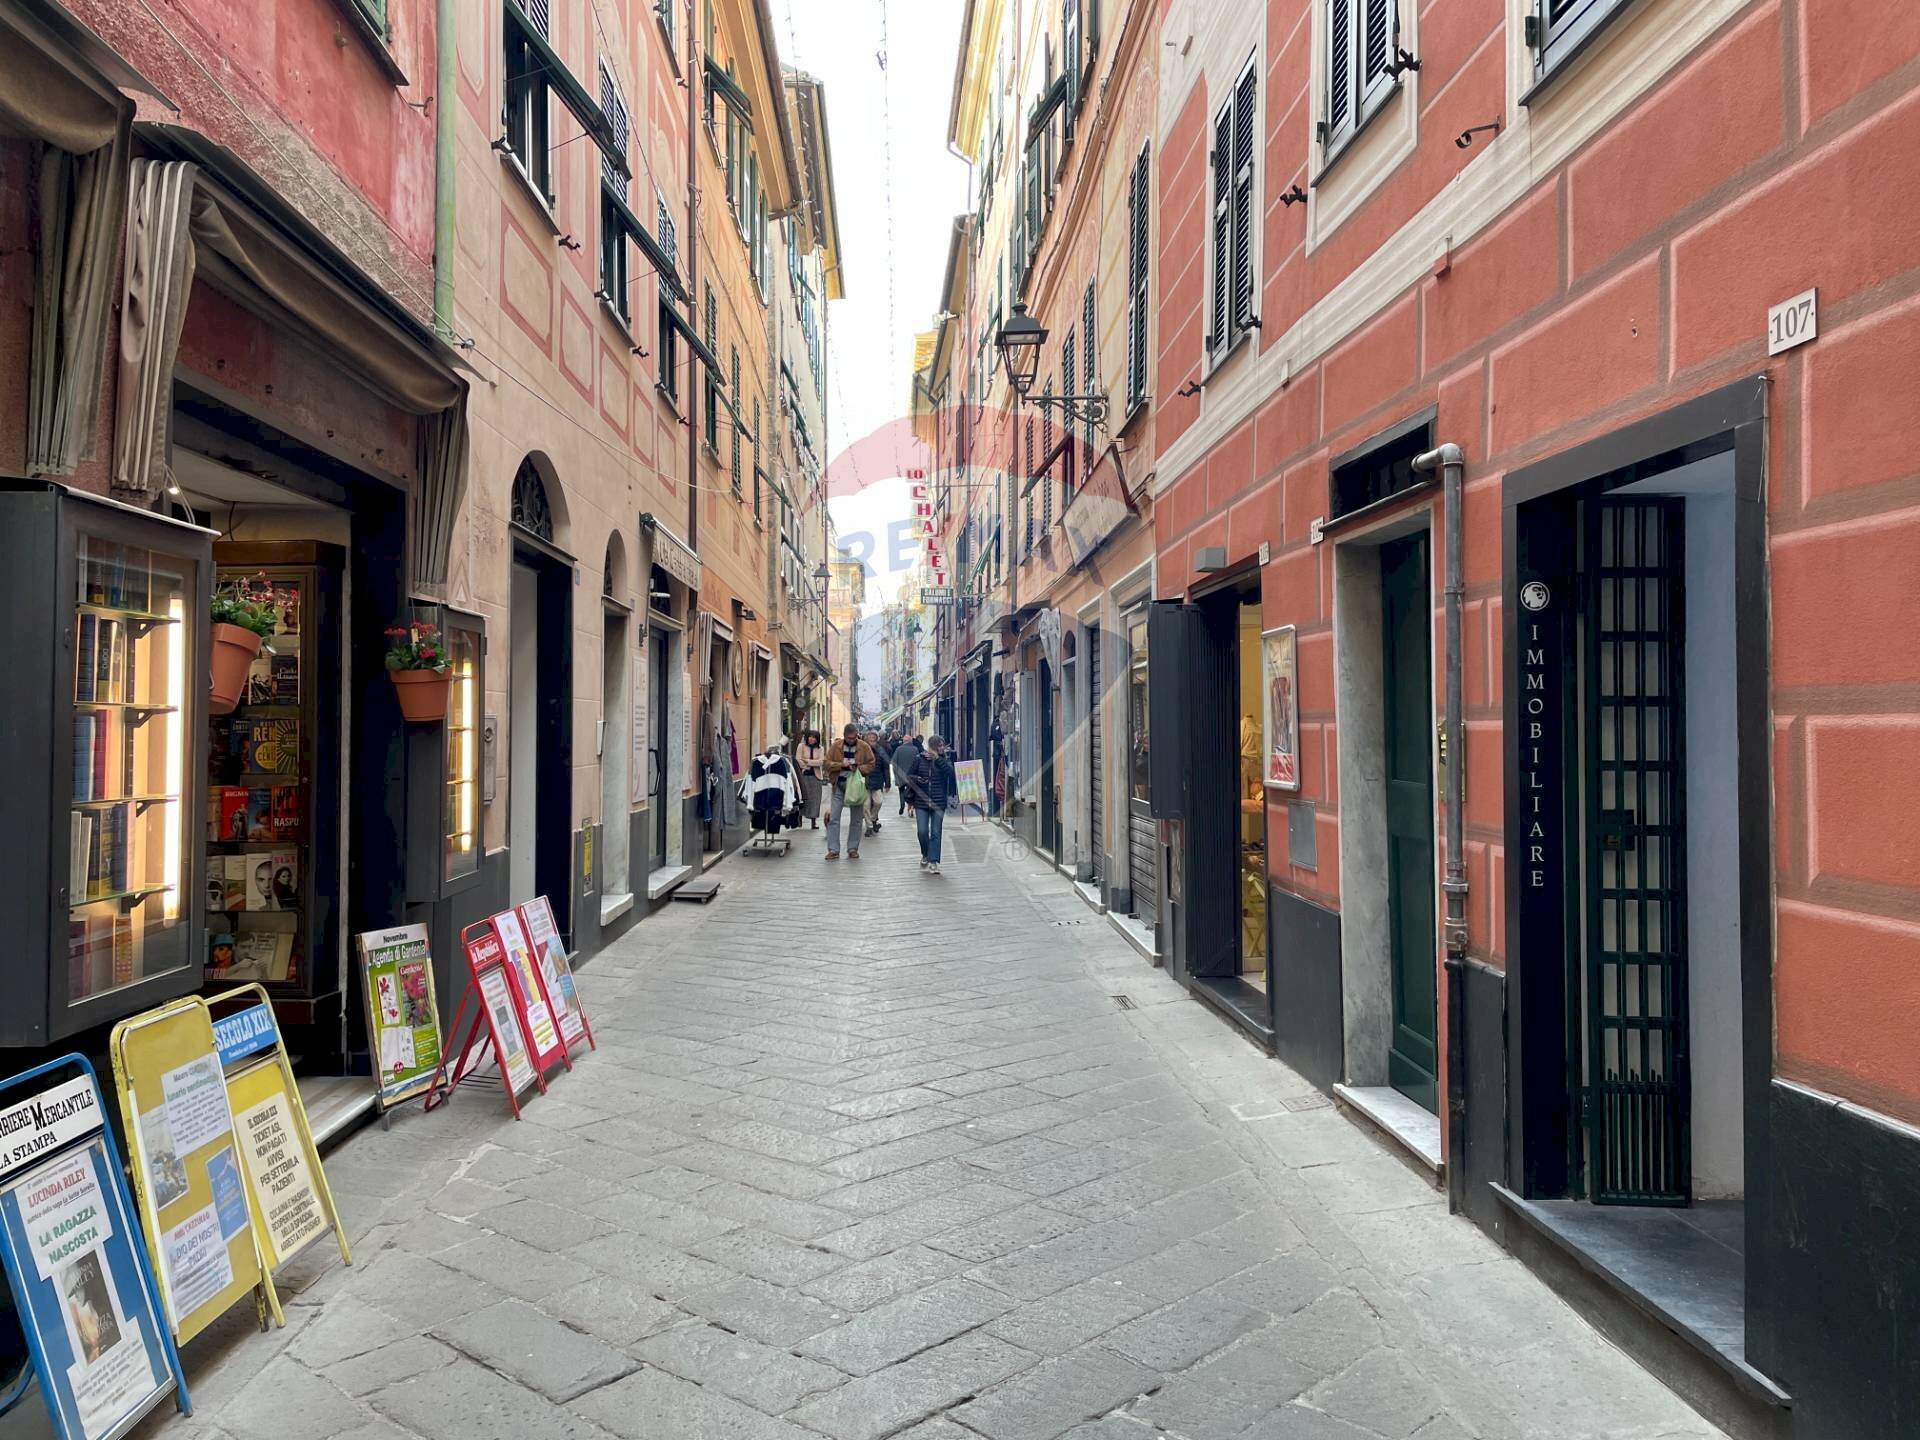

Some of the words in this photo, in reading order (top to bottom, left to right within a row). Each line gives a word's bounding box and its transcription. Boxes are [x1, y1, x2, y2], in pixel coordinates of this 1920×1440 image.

[1772, 298, 1812, 344] 107
[907, 470, 923, 480] LO
[913, 486, 945, 585] CHALET
[1526, 624, 1544, 887] IMMOBILIARE
[274, 817, 299, 828] RASPU
[383, 933, 408, 943] Novembre
[215, 1015, 254, 1051] SECOLO
[250, 1007, 272, 1035] XIX
[29, 1088, 94, 1131] MERCANTILE
[12, 1131, 57, 1161] STAMPA
[253, 1126, 271, 1144] TICKET
[271, 1121, 282, 1135] ASL
[255, 1143, 268, 1158] NON
[267, 1132, 287, 1152] PAGATI
[260, 1173, 271, 1187] PER
[270, 1155, 300, 1180] SETTEMILA
[266, 1149, 285, 1167] AVVISI
[27, 1181, 64, 1209] LUCINDA
[63, 1167, 86, 1189] RILEY
[271, 1172, 296, 1195] PAZIENTI
[38, 1231, 53, 1247] LA
[52, 1205, 97, 1239] RAGAZZA
[48, 1226, 98, 1264] NASCOSTA
